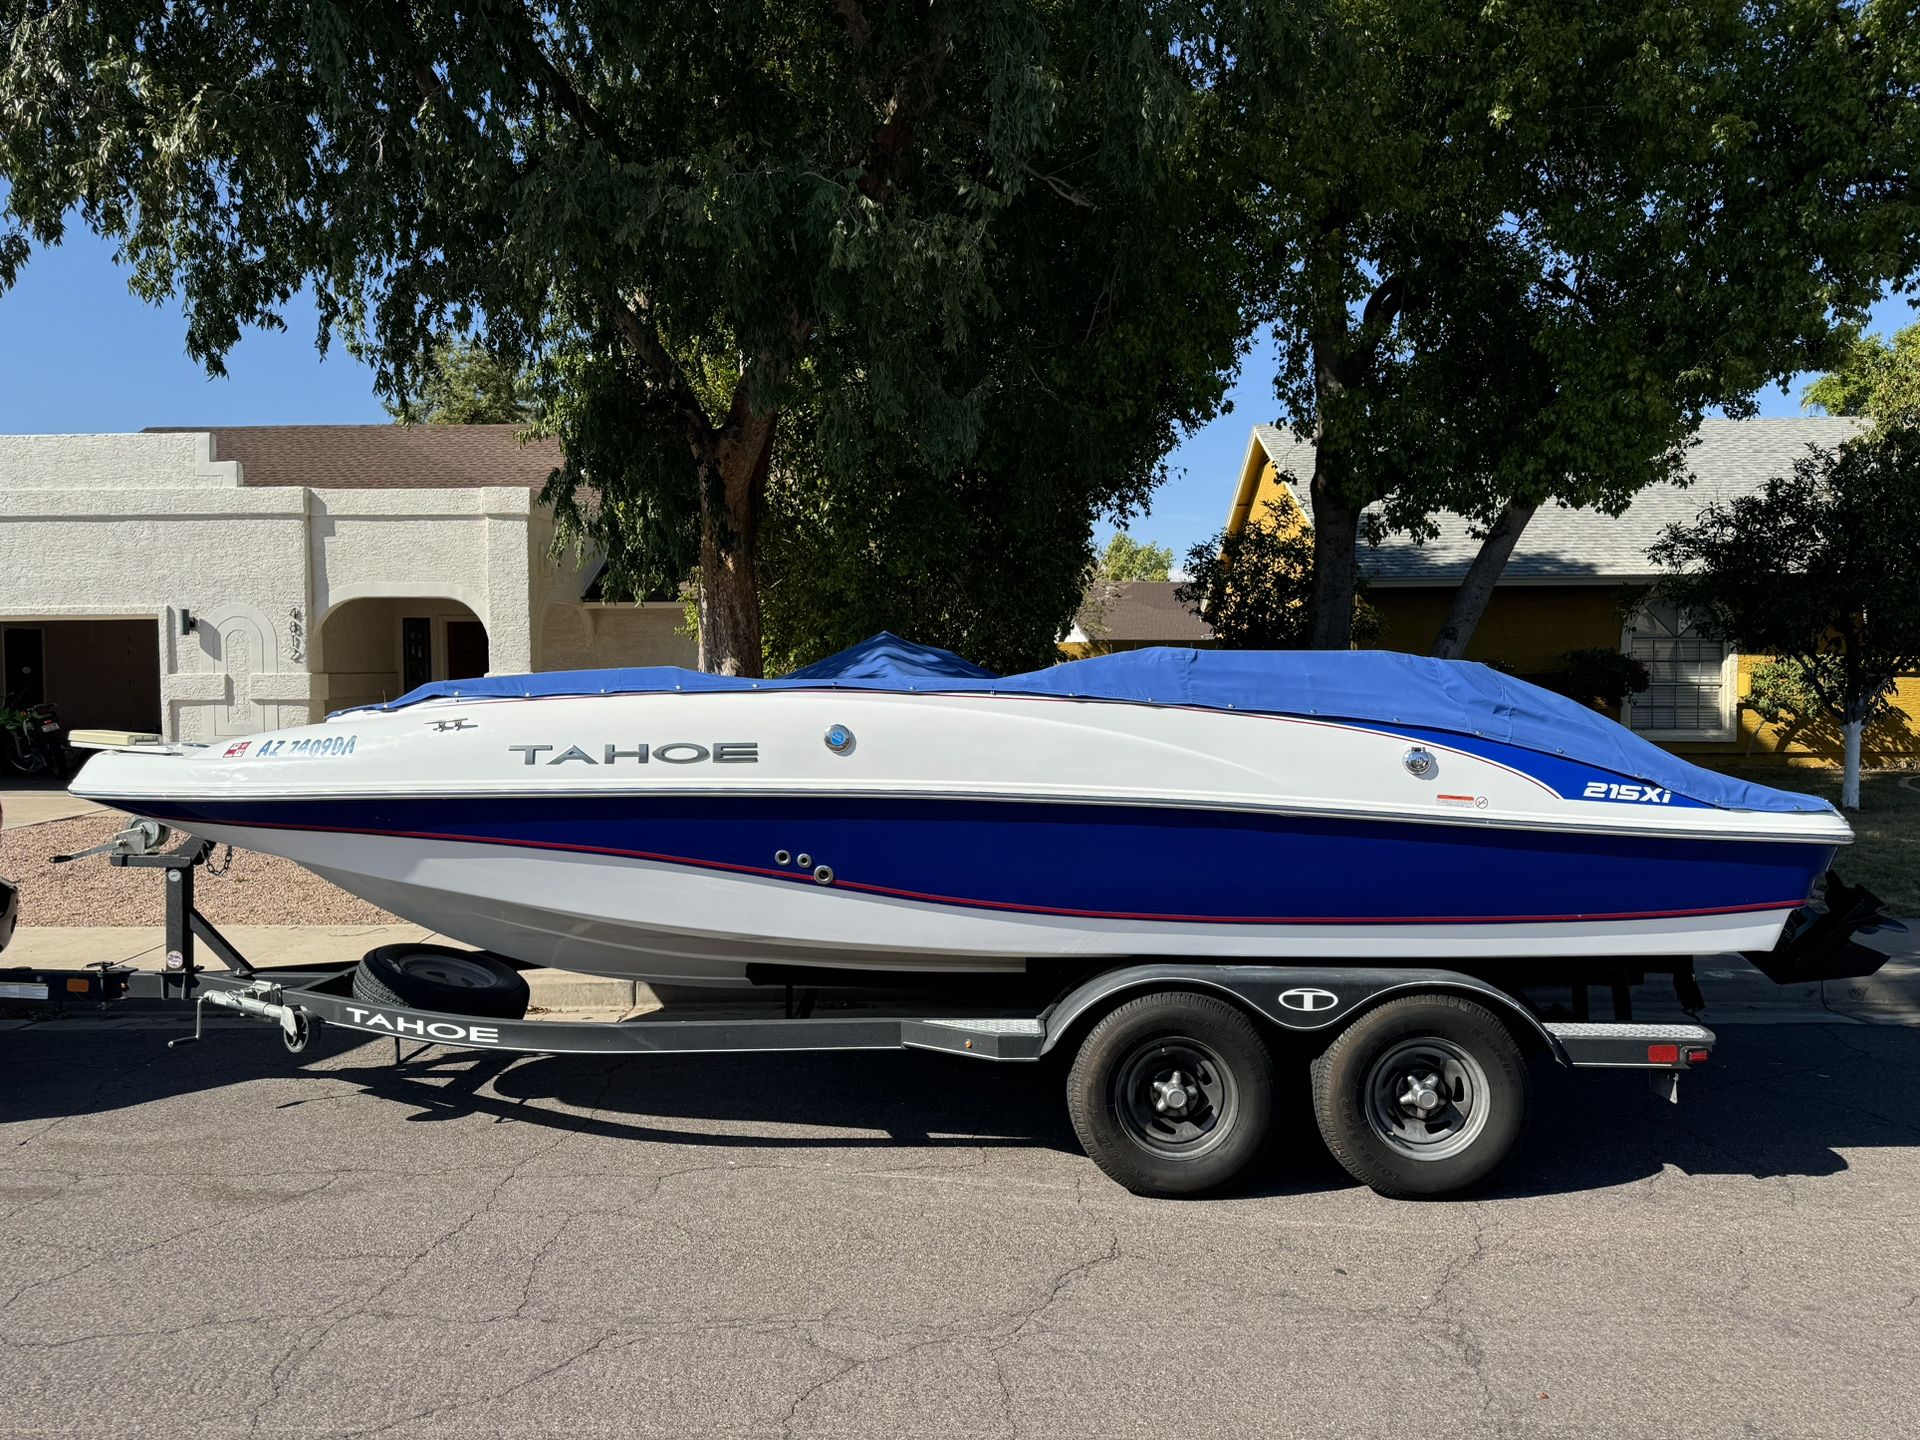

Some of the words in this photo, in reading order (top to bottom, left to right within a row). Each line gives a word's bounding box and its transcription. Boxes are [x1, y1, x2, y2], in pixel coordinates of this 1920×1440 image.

[256, 740, 286, 757] AZ
[508, 742, 759, 765] TAHOE
[1583, 781, 1672, 804] 215Xi
[346, 1007, 499, 1043] TAHOE
